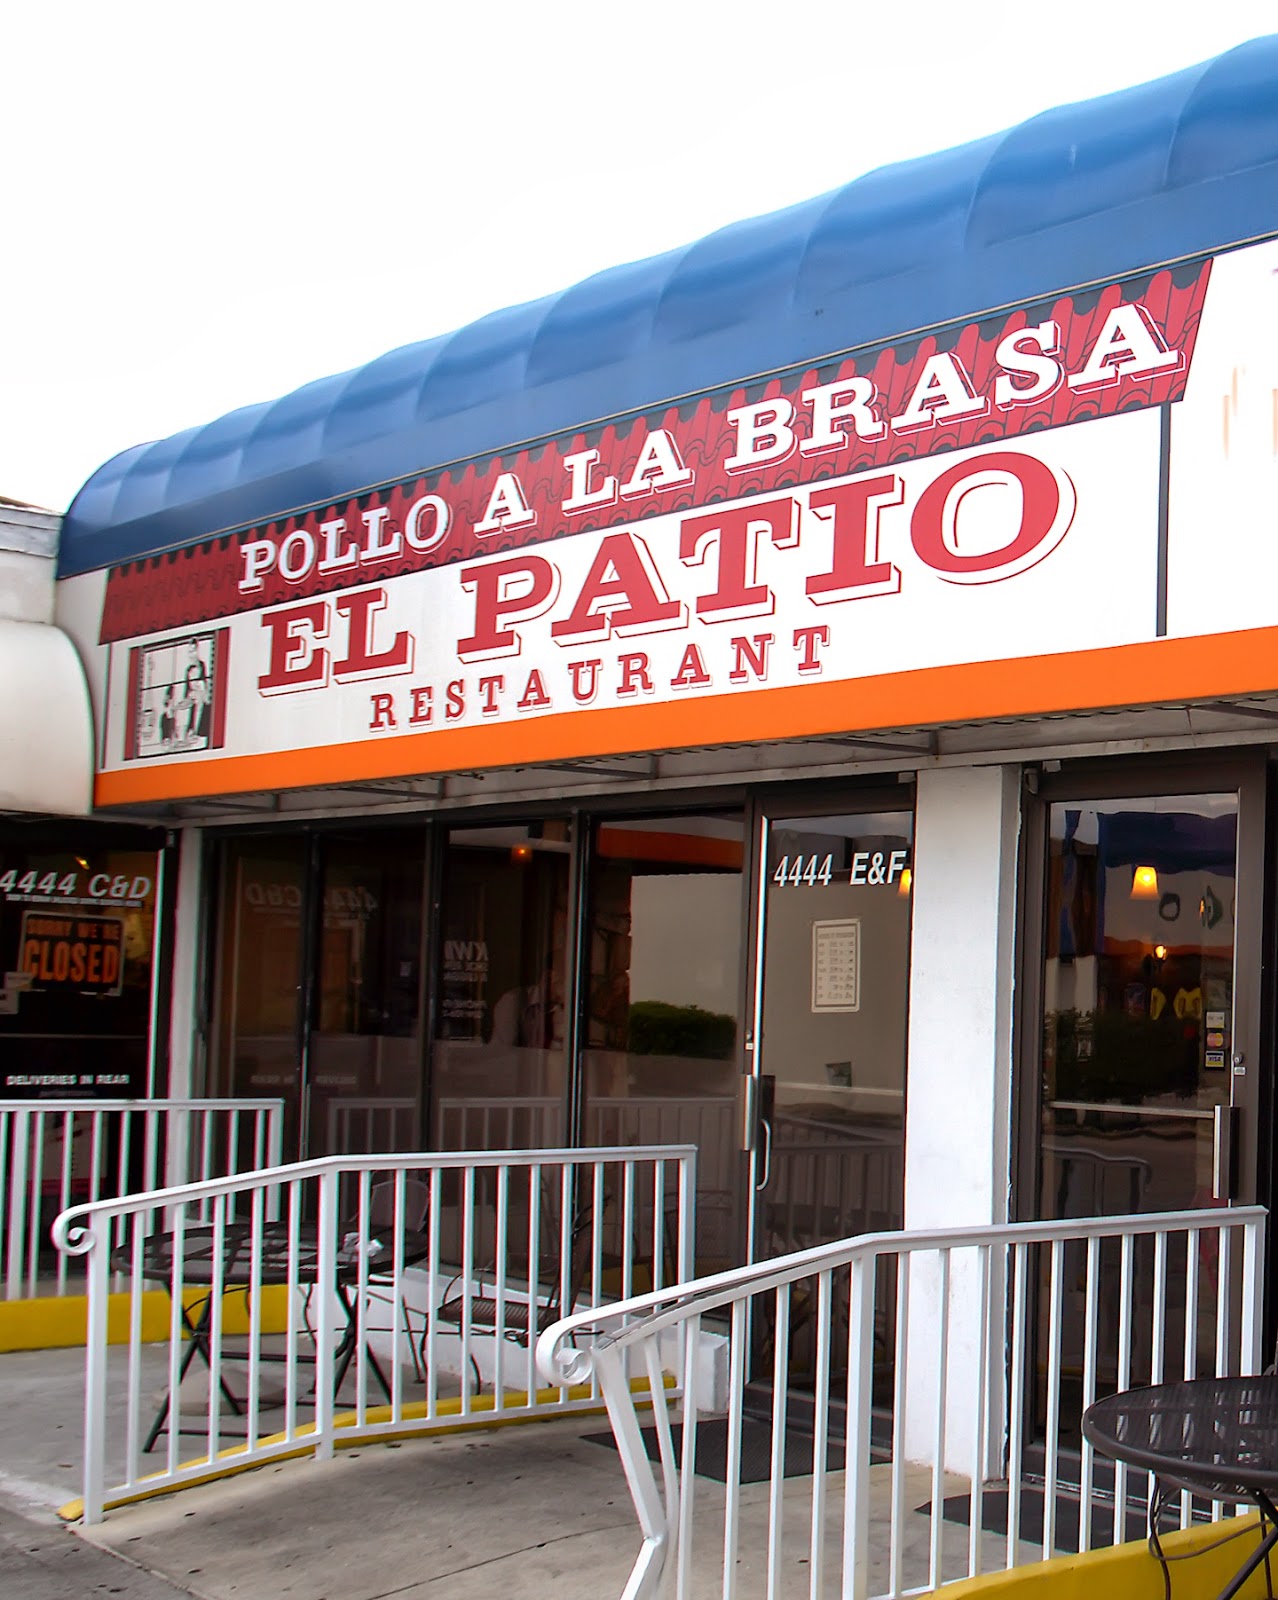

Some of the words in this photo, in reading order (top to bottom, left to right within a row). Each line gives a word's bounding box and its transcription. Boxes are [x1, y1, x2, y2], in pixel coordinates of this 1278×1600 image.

[238, 494, 453, 594] POLLO
[473, 472, 536, 538] A
[562, 429, 694, 517] LA
[724, 303, 1186, 476] BRASA
[258, 587, 415, 698] EL
[456, 451, 1077, 664] PATIO
[369, 624, 830, 732] RESTAURANT
[0, 869, 78, 896] 4444
[88, 873, 152, 899] C&D
[774, 853, 833, 888] 4444
[849, 850, 908, 886] E&F
[22, 939, 120, 984] CLOSED
[6, 1074, 77, 1086] DELIVERIES
[79, 1074, 94, 1085] IN
[96, 1074, 130, 1085] REAR
